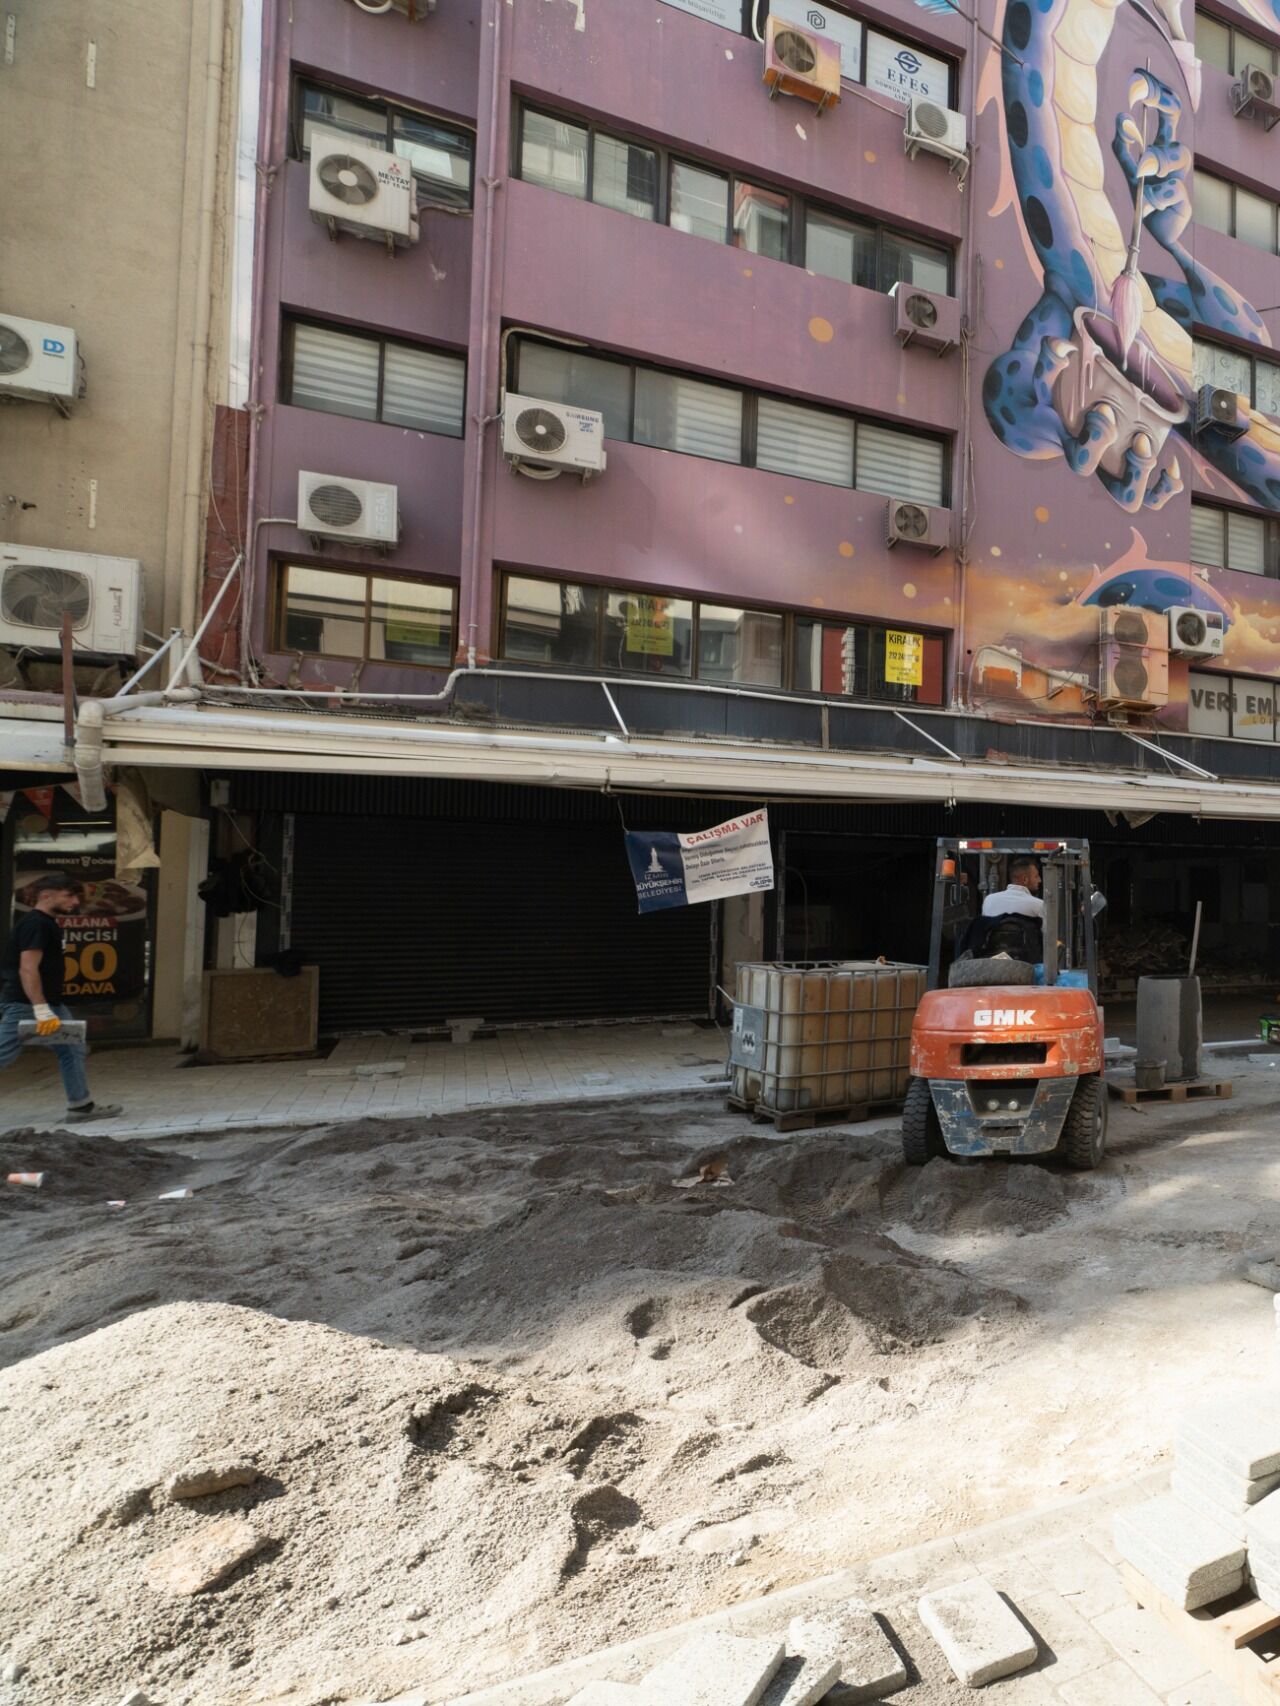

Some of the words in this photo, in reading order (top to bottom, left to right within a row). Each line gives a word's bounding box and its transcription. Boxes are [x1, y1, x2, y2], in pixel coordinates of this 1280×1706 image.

[887, 68, 929, 96] EFES
[378, 171, 410, 186] MENTAY
[686, 822, 740, 846] ÇALIŞMA
[741, 813, 765, 829] VAR
[46, 858, 80, 866] BEREKET
[64, 918, 110, 928] ALANA
[973, 1009, 1037, 1027] GMK
